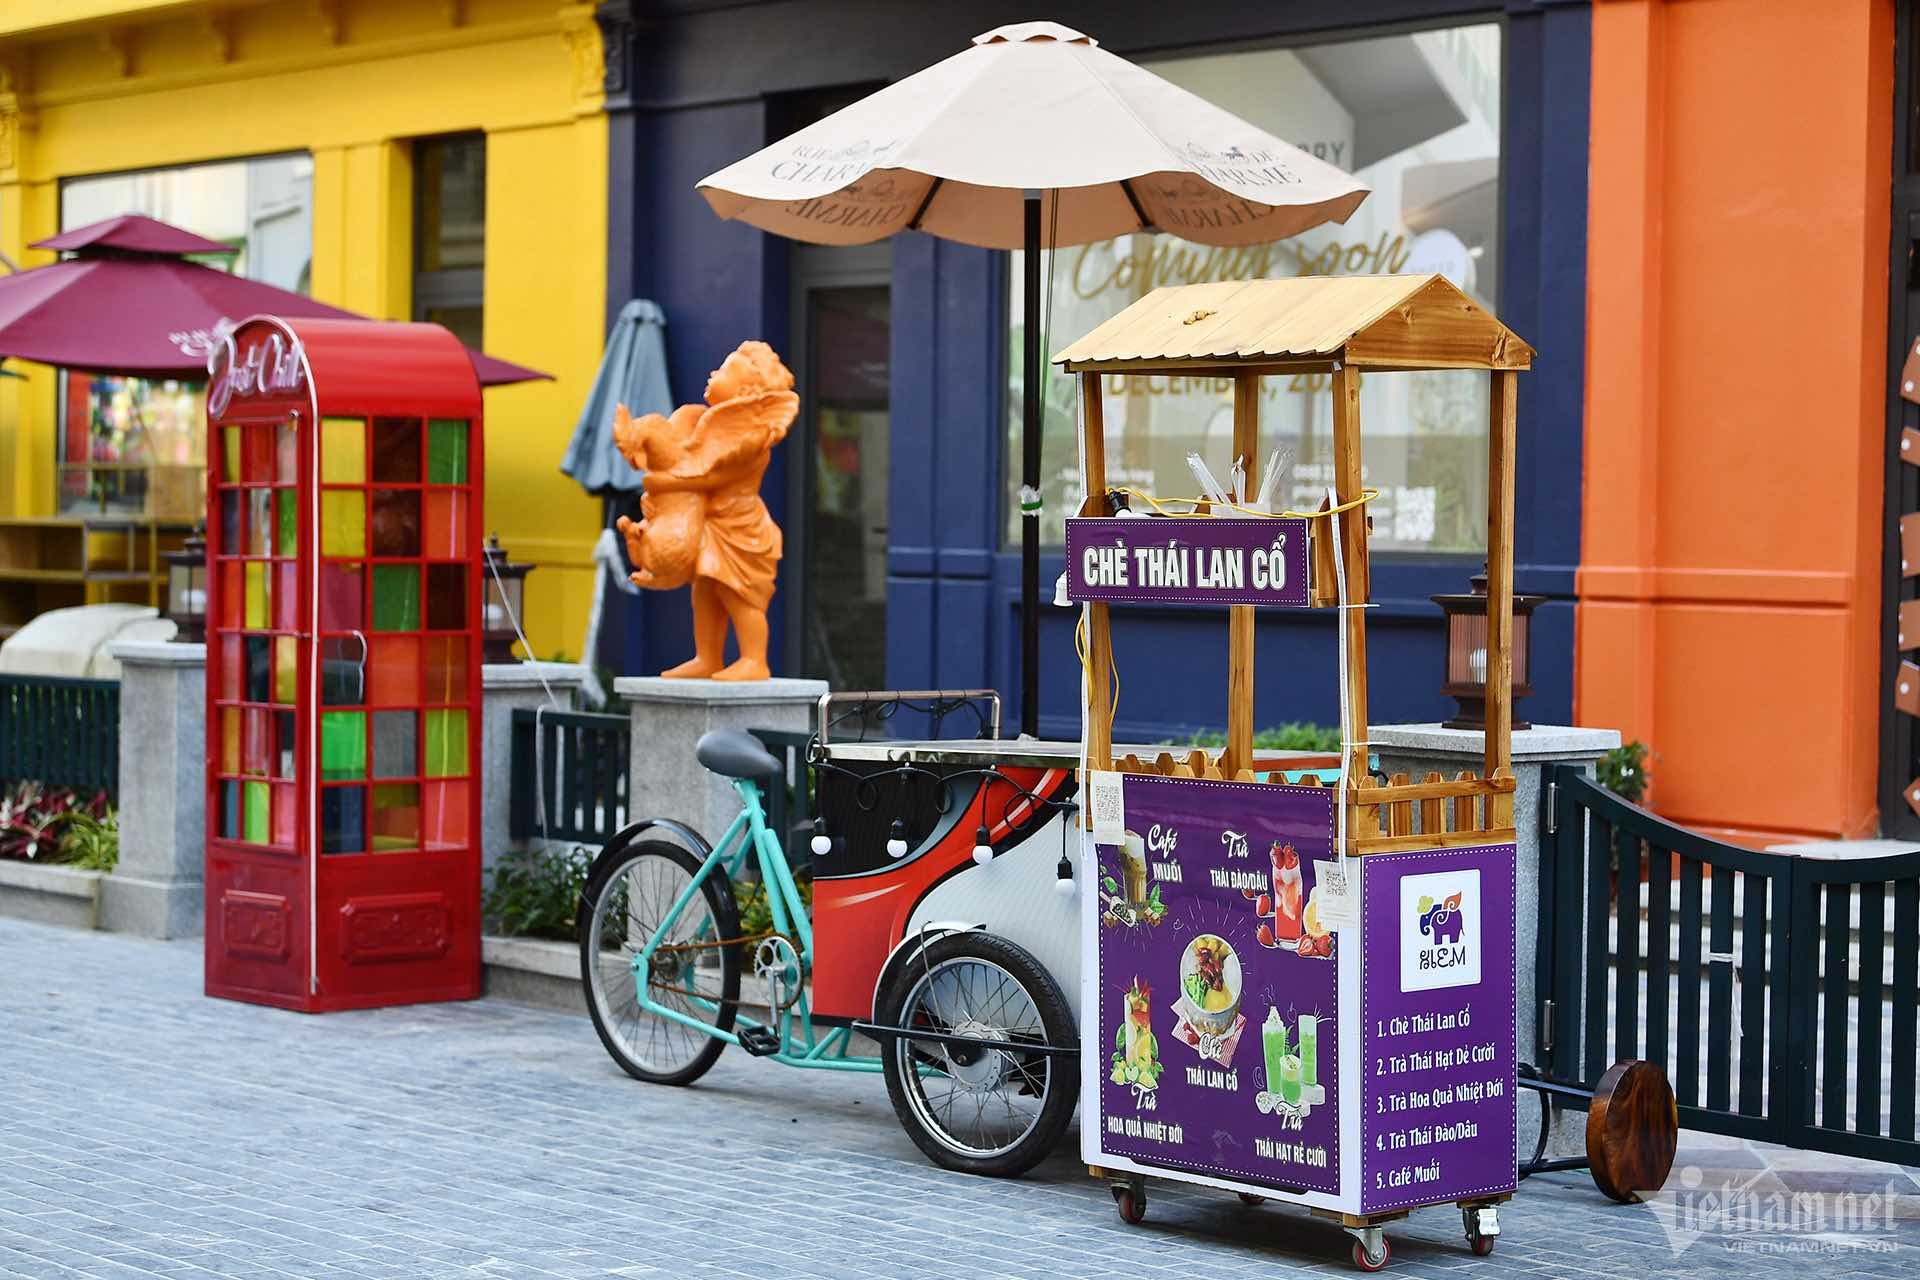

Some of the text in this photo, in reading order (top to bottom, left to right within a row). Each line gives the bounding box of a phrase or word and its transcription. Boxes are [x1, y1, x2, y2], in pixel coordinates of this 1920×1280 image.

[1083, 532, 1287, 591] CHÈ THÁI LAN CỔ
[1148, 824, 1178, 859] Café
[1221, 830, 1249, 858] Trà
[1210, 867, 1229, 888] THÁI
[1377, 1003, 1470, 1038] 1. Chè Thái Lan Cổ
[1199, 1032, 1222, 1060] Chè
[1376, 1058, 1387, 1076] 2.
[1389, 1054, 1407, 1074] Trà
[1410, 1050, 1433, 1071] Thái
[1435, 1049, 1454, 1071] Hạt
[1472, 1042, 1495, 1063] Cười
[1185, 1065, 1238, 1092] THÁI LAN CỔ
[1131, 1082, 1158, 1111] Trà
[1389, 1091, 1407, 1112] Trà
[1409, 1091, 1430, 1109] Hoa
[1432, 1084, 1453, 1108] Quả
[1456, 1081, 1484, 1104] Nhiệt
[1486, 1078, 1504, 1098] Đới
[1107, 1115, 1124, 1135] HOA
[1125, 1115, 1143, 1138] QUẢ
[1389, 1129, 1407, 1150] Trà
[1409, 1125, 1432, 1147] Thái
[1435, 1119, 1478, 1143] Đào/Dâu
[1255, 1137, 1274, 1158] THÁI
[1275, 1142, 1292, 1165] HẠT
[1388, 1166, 1411, 1188] Café
